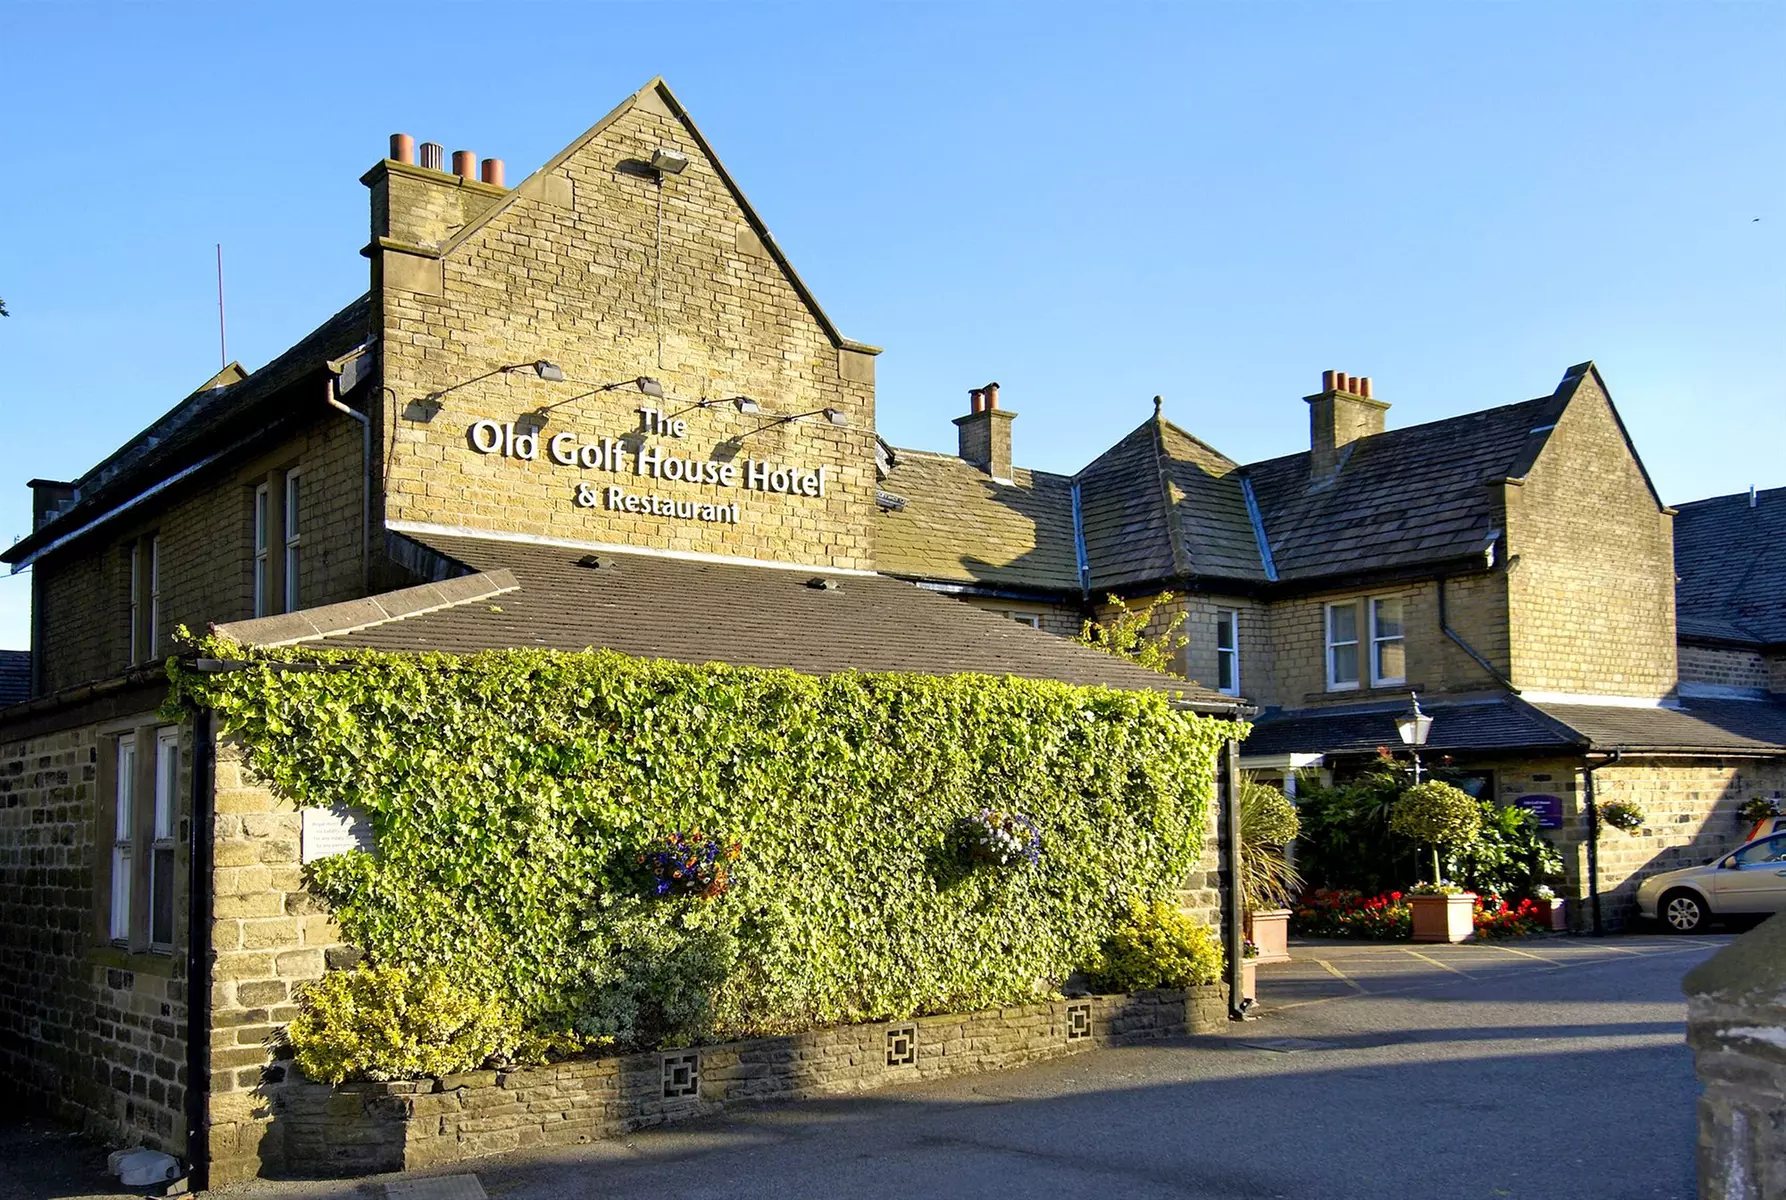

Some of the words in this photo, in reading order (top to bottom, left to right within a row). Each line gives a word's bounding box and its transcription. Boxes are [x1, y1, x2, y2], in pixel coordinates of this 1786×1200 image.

[639, 406, 687, 437] The
[472, 419, 539, 460] Old
[551, 432, 626, 472] Golf
[638, 445, 737, 486] House
[748, 459, 826, 497] Hotel
[577, 481, 598, 507] &
[608, 485, 741, 524] Restaurant
